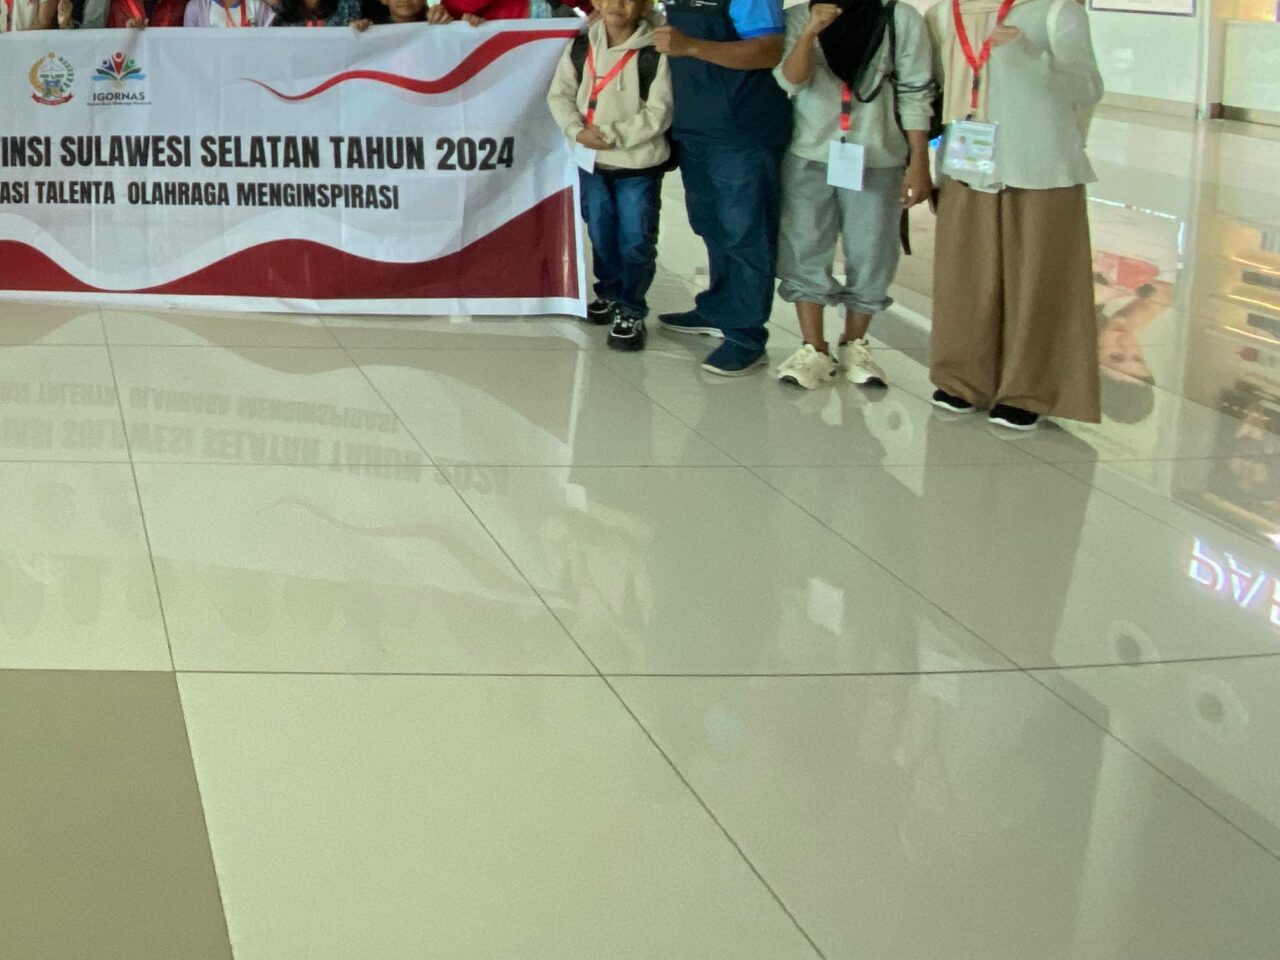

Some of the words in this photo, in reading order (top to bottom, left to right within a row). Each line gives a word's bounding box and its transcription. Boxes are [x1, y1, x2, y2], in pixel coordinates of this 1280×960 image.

[92, 91, 145, 102] IGORNAS
[60, 135, 191, 168] SULAWESI
[200, 135, 320, 169] SELATAN
[329, 136, 426, 170] TAHUN
[435, 135, 515, 171] 2024
[34, 180, 115, 205] TALENTA
[127, 181, 230, 206] OLAHRAGA
[236, 182, 399, 210] MENGINSPIRASI
